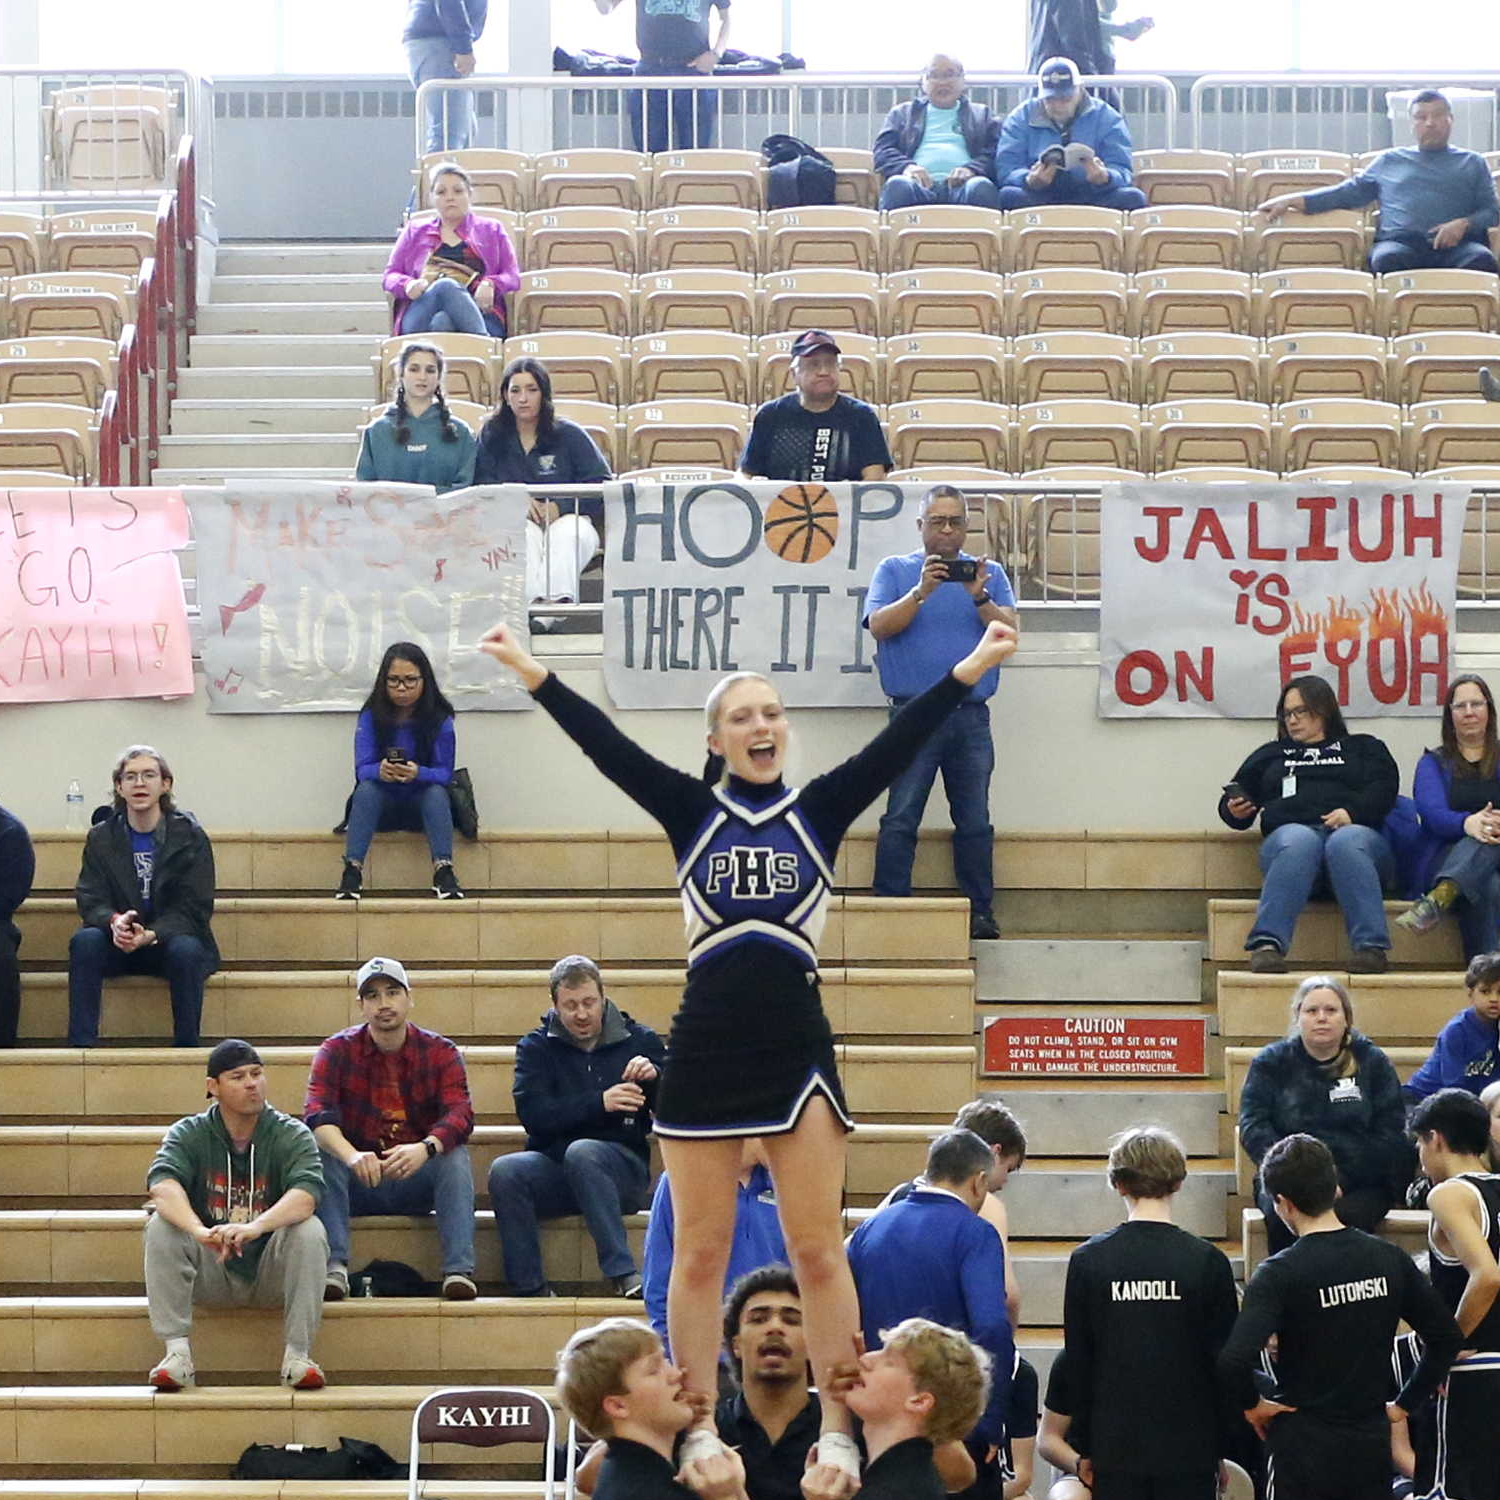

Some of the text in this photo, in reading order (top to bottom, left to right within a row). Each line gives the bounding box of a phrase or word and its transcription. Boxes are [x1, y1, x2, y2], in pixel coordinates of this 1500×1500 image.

[664, 473, 708, 482] RESERVED
[1134, 493, 1443, 563] JALIUH
[16, 546, 93, 608] GO
[612, 586, 746, 672] THERE
[771, 585, 831, 673] IT
[1114, 646, 1214, 707] ON
[705, 844, 800, 900] PHS
[1065, 1018, 1125, 1034] CAUTION
[1008, 1036, 1178, 1048] DO NOT CLIMB, STAND, OR SIT ON GYM
[1009, 1049, 1174, 1059] SEATS WHEN IN THE CLOSED POSITION.
[1010, 1062, 1180, 1073] IT WILL DAMAGE THE UNDERSTRUCTURE.
[1111, 1280, 1182, 1301] KANDOLL
[1319, 1276, 1389, 1308] LUTOMSKI
[437, 1405, 532, 1427] KAYHI
